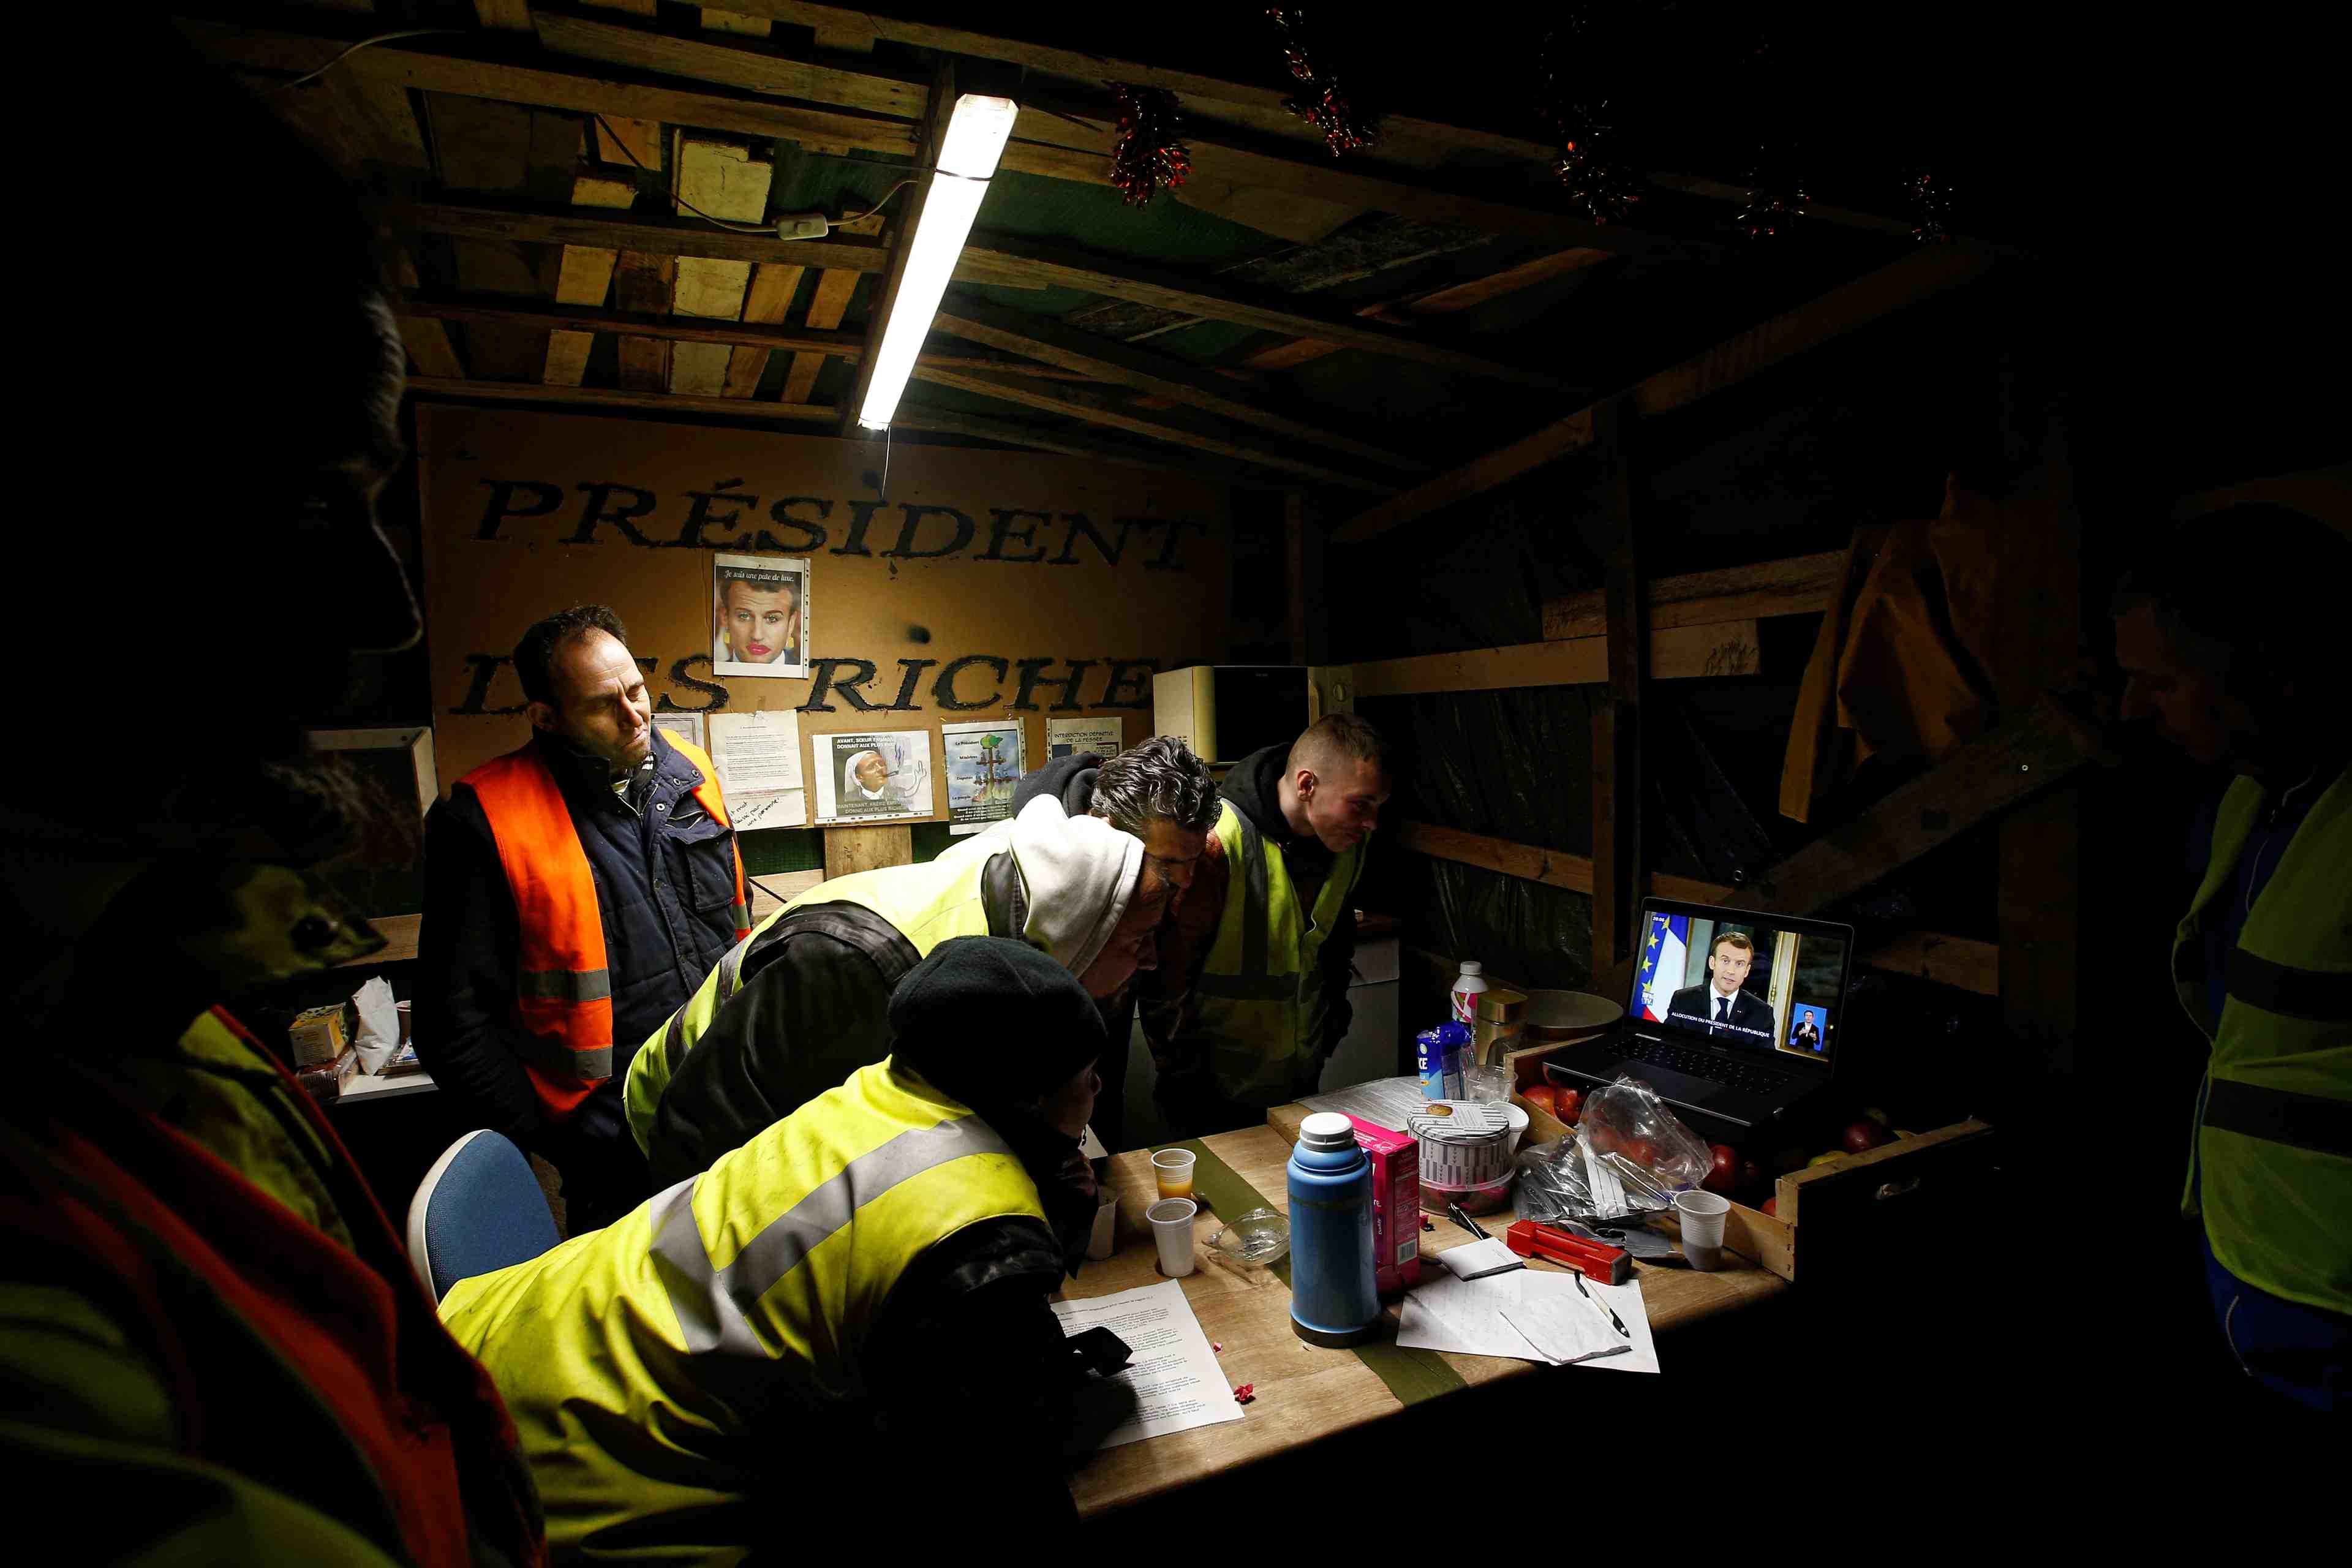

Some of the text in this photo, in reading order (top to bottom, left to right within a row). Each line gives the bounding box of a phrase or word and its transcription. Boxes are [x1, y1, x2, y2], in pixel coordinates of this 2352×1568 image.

[470, 478, 1208, 571] PRÉSIDENT
[725, 570, 732, 578] Je
[450, 655, 729, 714] DS
[1671, 1012, 1697, 1021] ALLOCUTION
[1705, 1019, 1728, 1028] PRÉSIDENT
[1742, 1027, 1770, 1038] RÉPUBLIQUE
